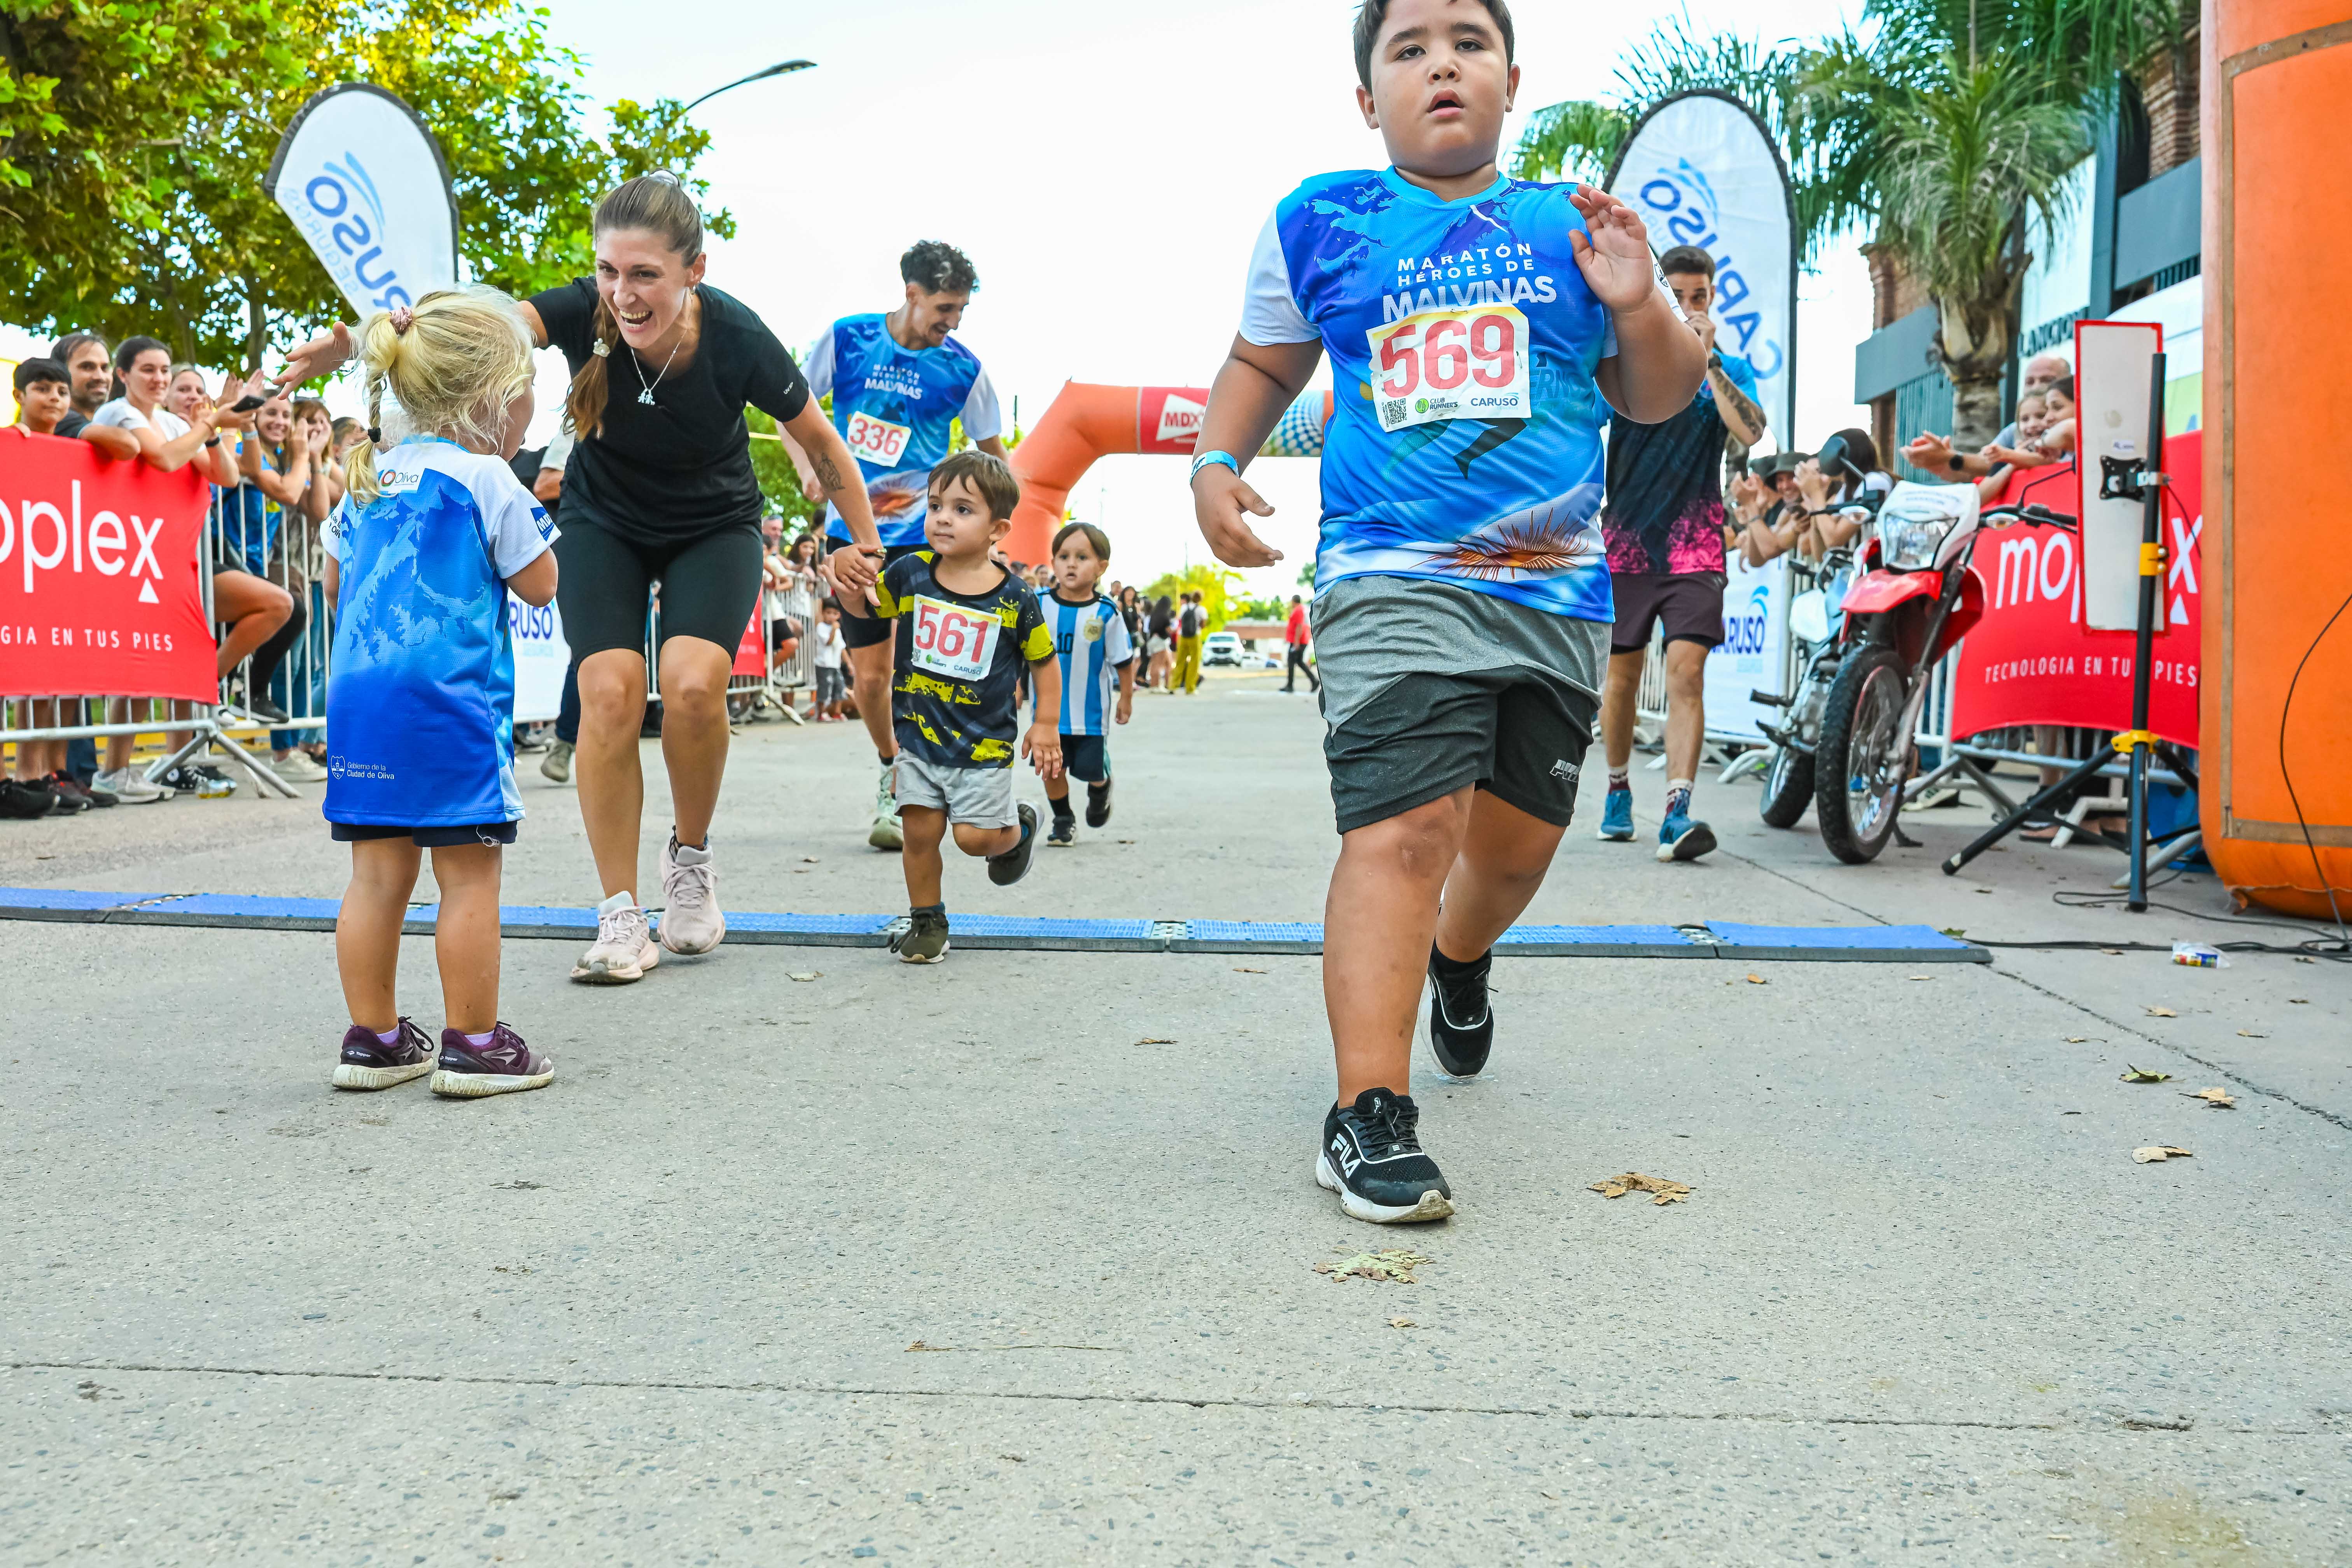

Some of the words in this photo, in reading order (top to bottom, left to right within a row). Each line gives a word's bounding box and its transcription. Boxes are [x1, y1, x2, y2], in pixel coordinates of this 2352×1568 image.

[1397, 243, 1532, 272] MARATÓN
[1398, 263, 1493, 287] HÉROES
[1505, 259, 1534, 272] DE
[1383, 275, 1557, 323] MALVINAS
[1381, 315, 1515, 398] 569
[864, 378, 923, 400] MALVINAS
[1430, 402, 1458, 410] RUNNER'S
[1470, 398, 1518, 406] CARUSO
[850, 418, 903, 455] 336
[395, 472, 419, 483] Oliva
[536, 514, 553, 532] MD
[52, 627, 73, 646] EN
[84, 628, 119, 648] TUS
[133, 632, 173, 652] PIES
[915, 604, 989, 663] 561
[1057, 632, 1074, 654] 10
[954, 665, 981, 675] CARUSO
[1985, 656, 2074, 684] TECNOLOGIA
[2084, 656, 2102, 675] EN
[2112, 657, 2131, 677] TU
[2155, 660, 2196, 687] PIES
[347, 762, 370, 770] Gobierno
[347, 770, 365, 778] Ciudad
[1331, 1132, 1361, 1179] FILA
